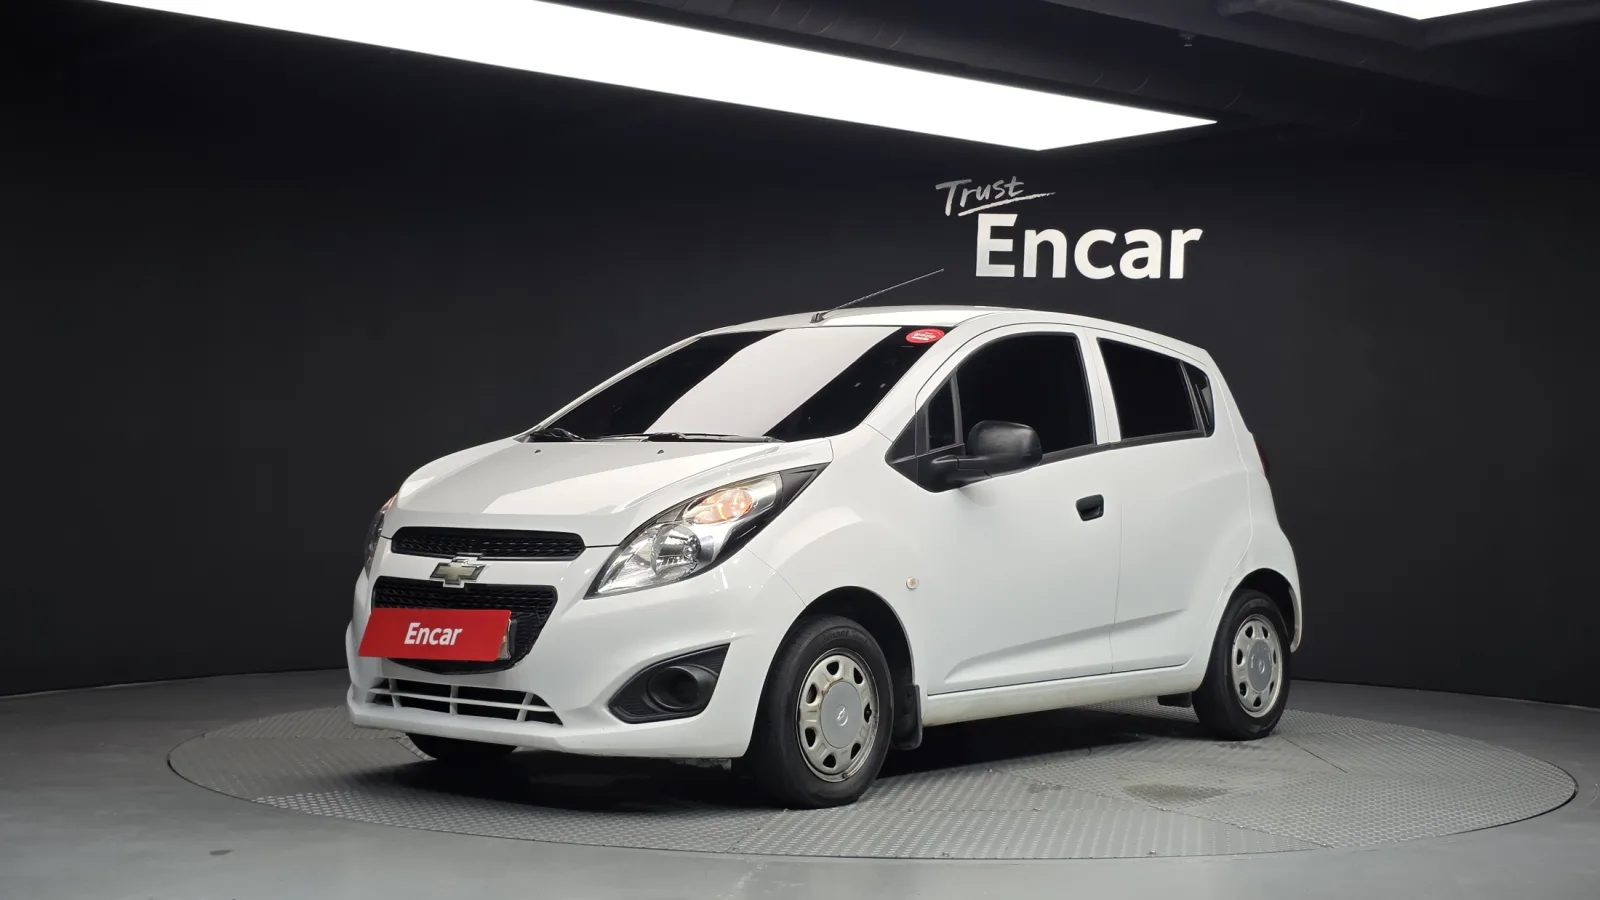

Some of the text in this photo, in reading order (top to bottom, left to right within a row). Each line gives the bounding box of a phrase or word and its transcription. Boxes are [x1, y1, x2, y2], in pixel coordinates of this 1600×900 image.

[936, 177, 1025, 216] Trust
[976, 213, 1204, 279] Encar
[404, 622, 463, 645] Encar
